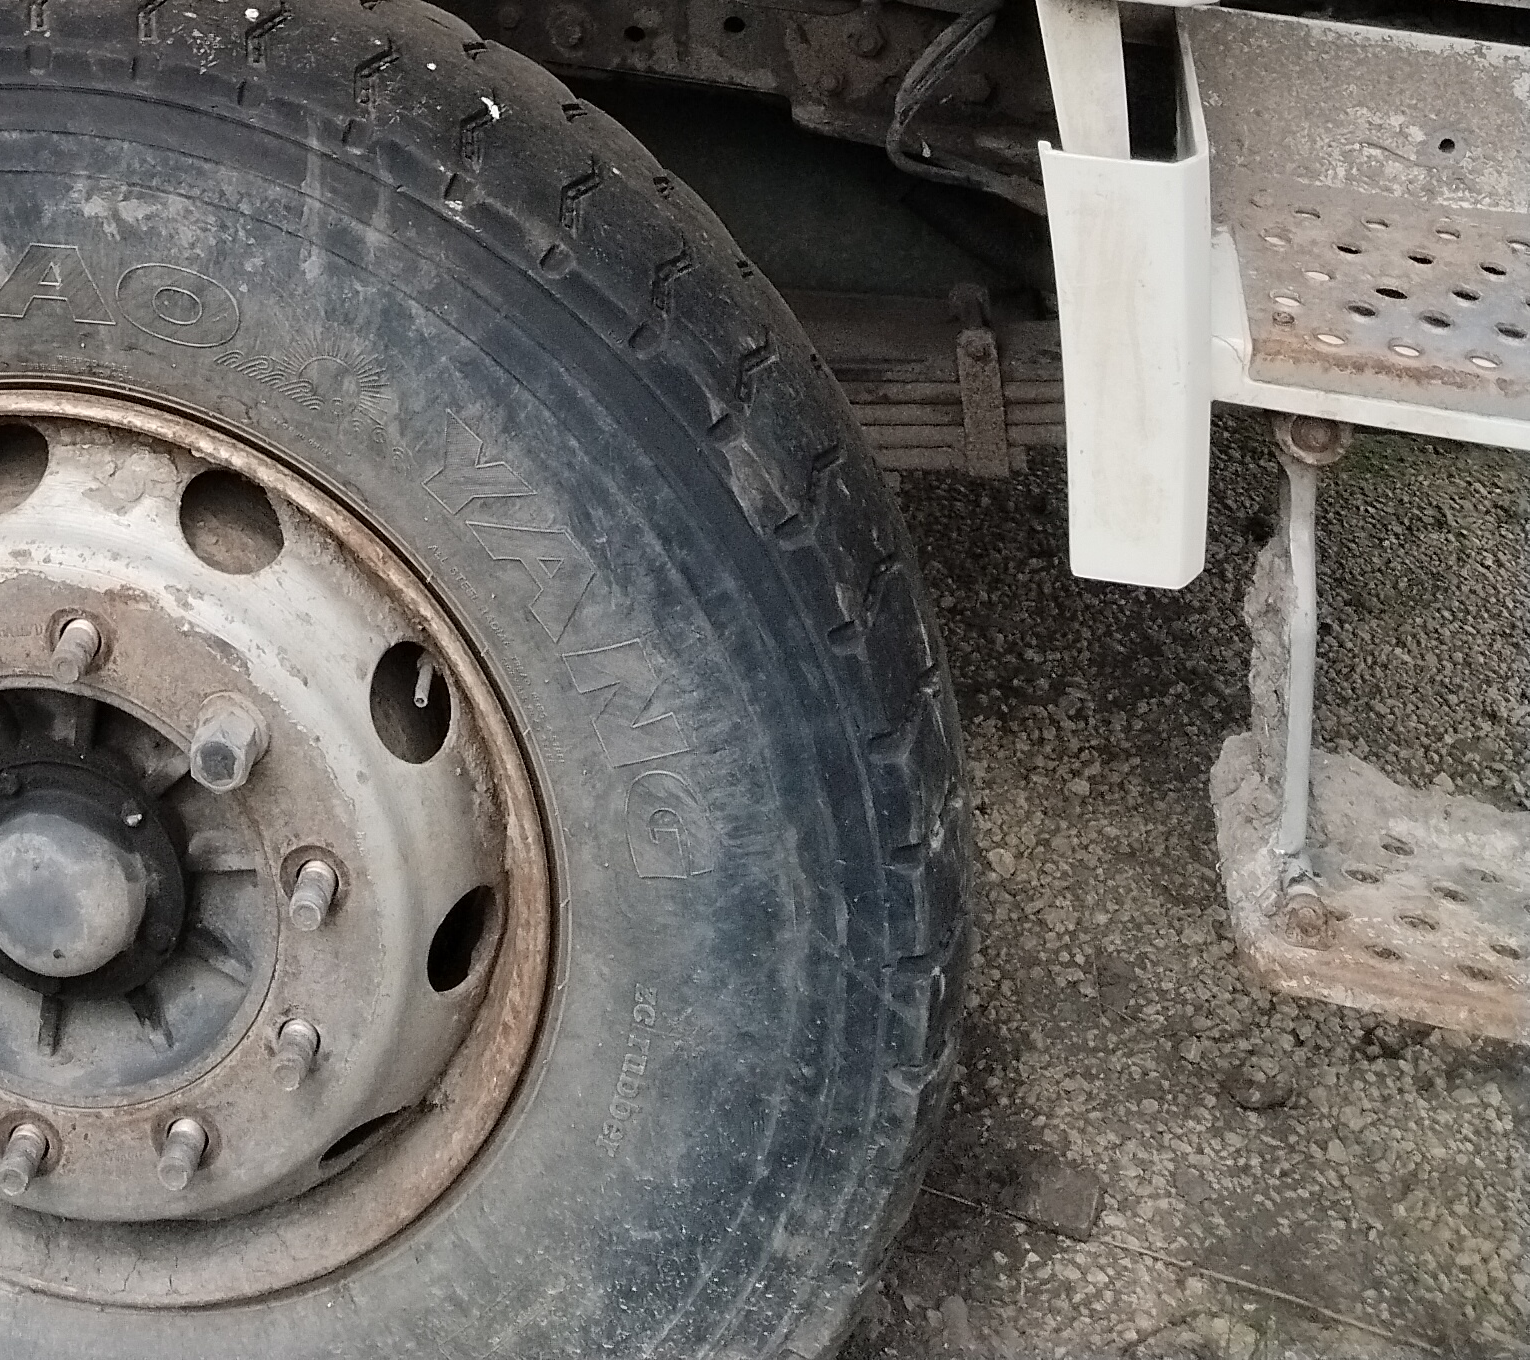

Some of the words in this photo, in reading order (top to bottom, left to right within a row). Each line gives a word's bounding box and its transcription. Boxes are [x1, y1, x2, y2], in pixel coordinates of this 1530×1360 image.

[420, 409, 713, 879] YANG
[449, 565, 479, 601] STEEL
[594, 1033, 652, 1158] rubber
